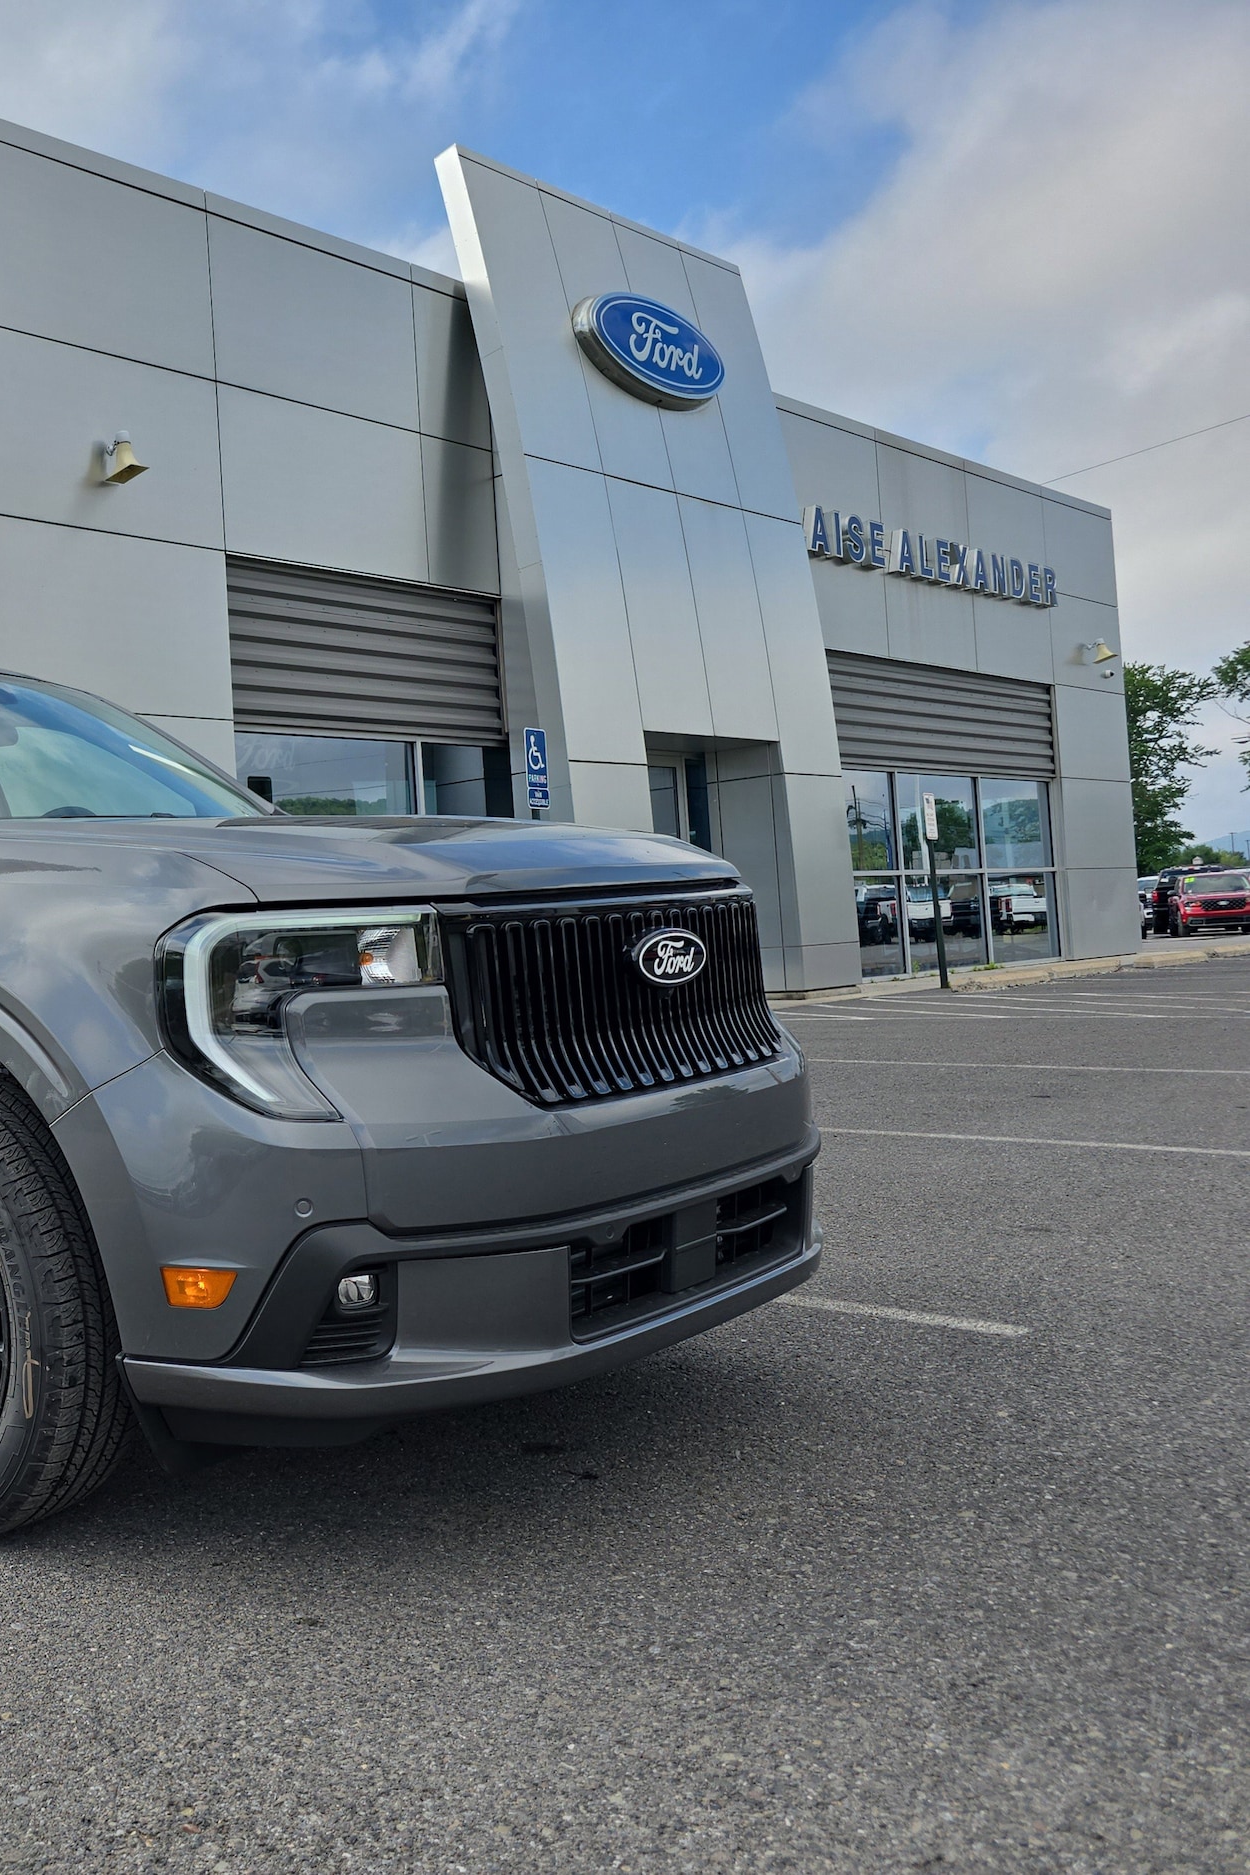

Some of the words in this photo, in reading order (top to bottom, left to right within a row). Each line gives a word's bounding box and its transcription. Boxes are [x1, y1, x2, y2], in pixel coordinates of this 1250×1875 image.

[629, 311, 703, 380] Ford
[807, 504, 887, 568] AISE
[894, 528, 1059, 607] ALEXANDER
[528, 773, 547, 784] PARKING
[653, 940, 695, 975] Ford
